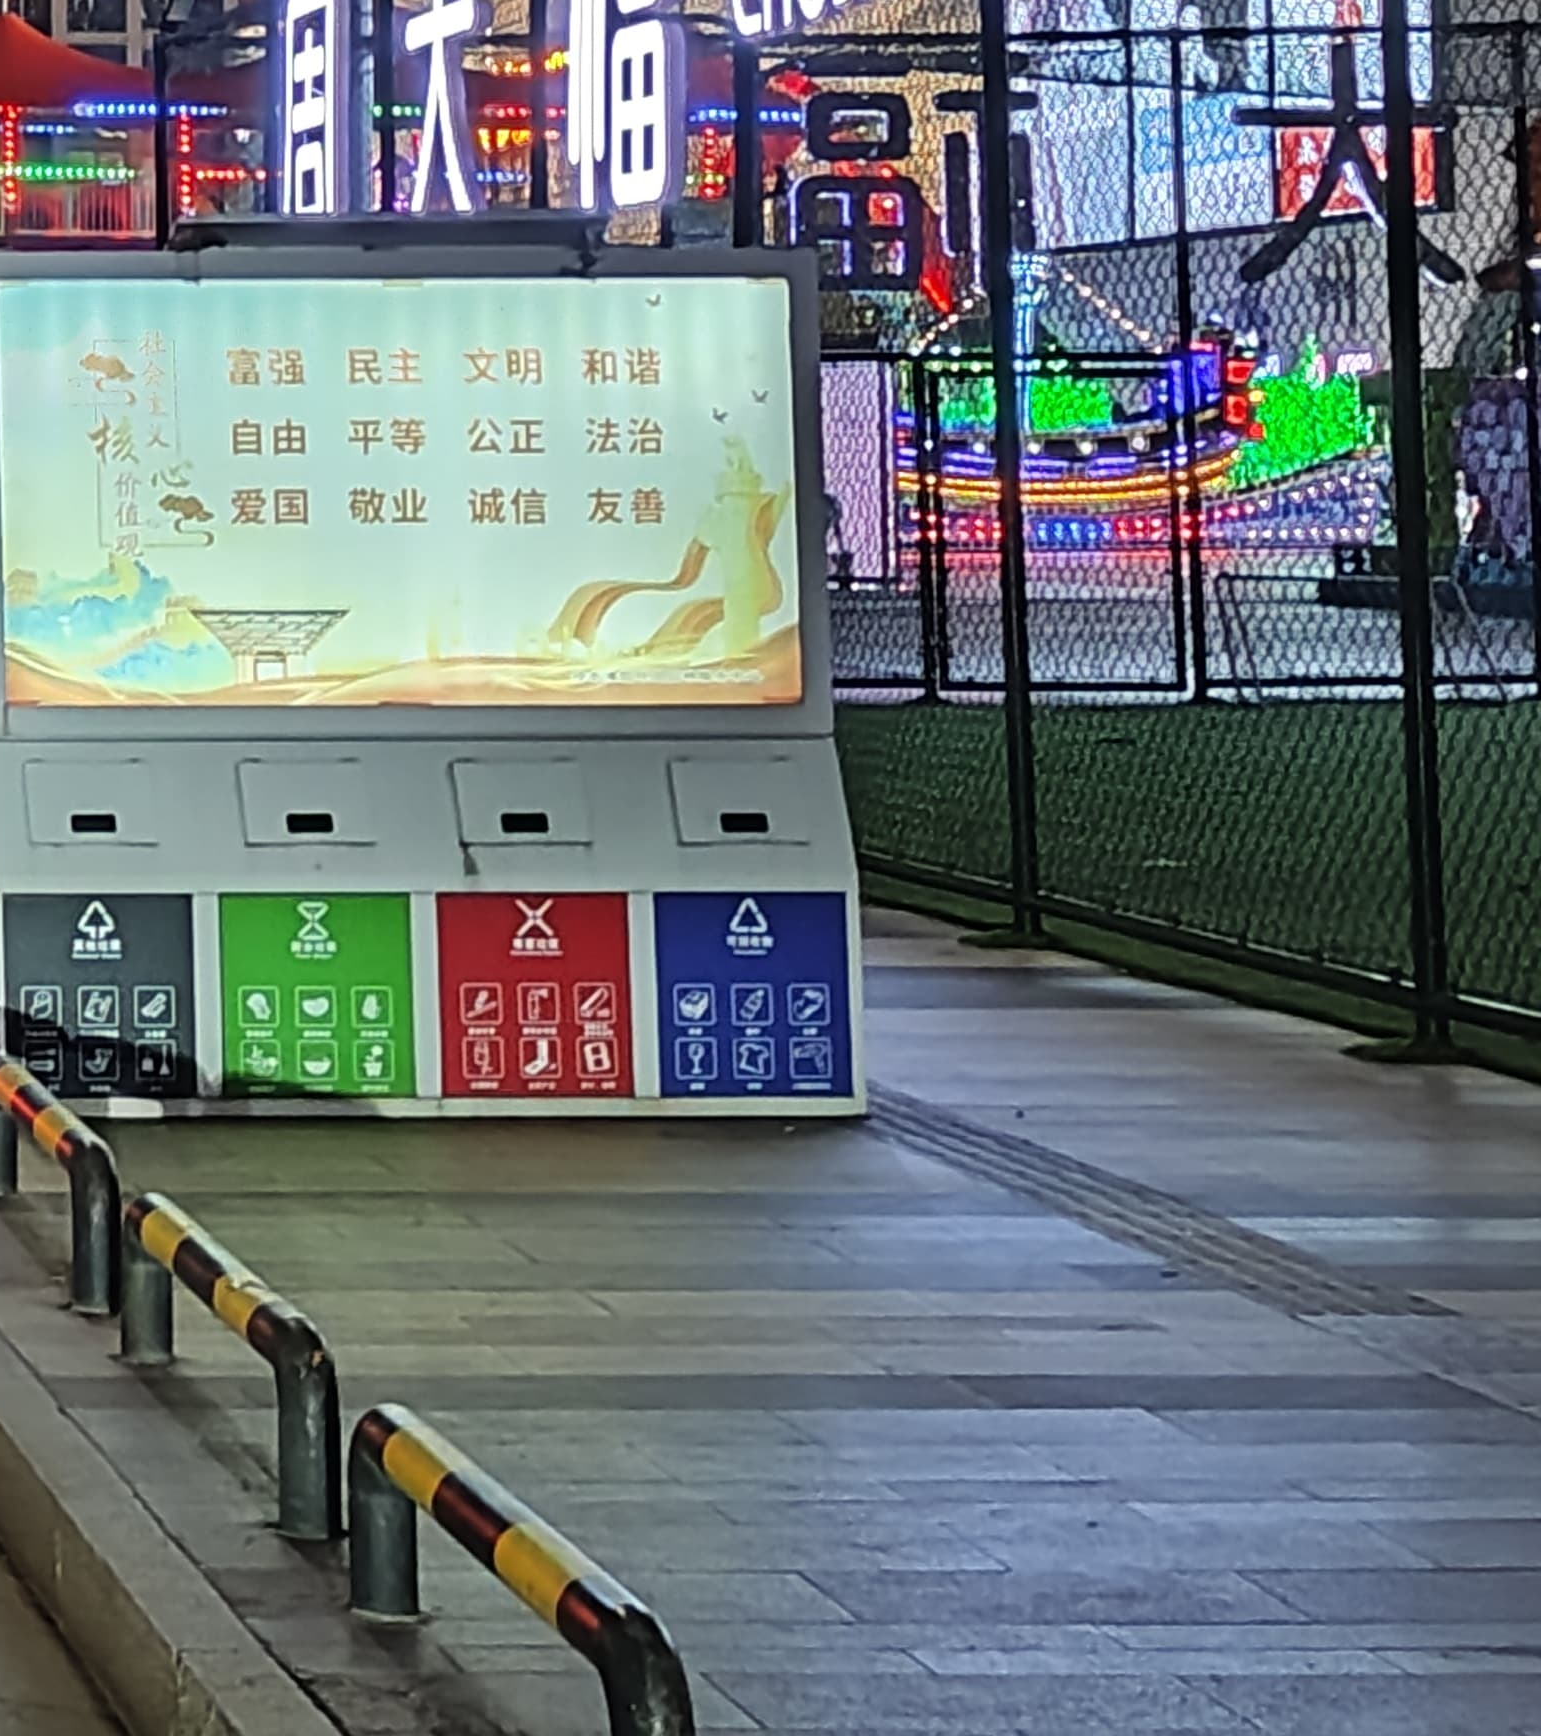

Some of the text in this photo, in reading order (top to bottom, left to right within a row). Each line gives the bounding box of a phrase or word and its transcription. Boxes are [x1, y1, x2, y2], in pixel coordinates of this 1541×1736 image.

[226, 346, 662, 385] 富强 民主 文明 和谐
[230, 417, 663, 456] 自由 平等 公正 法治
[230, 486, 666, 525] 爱国 敬业 诚信 友善
